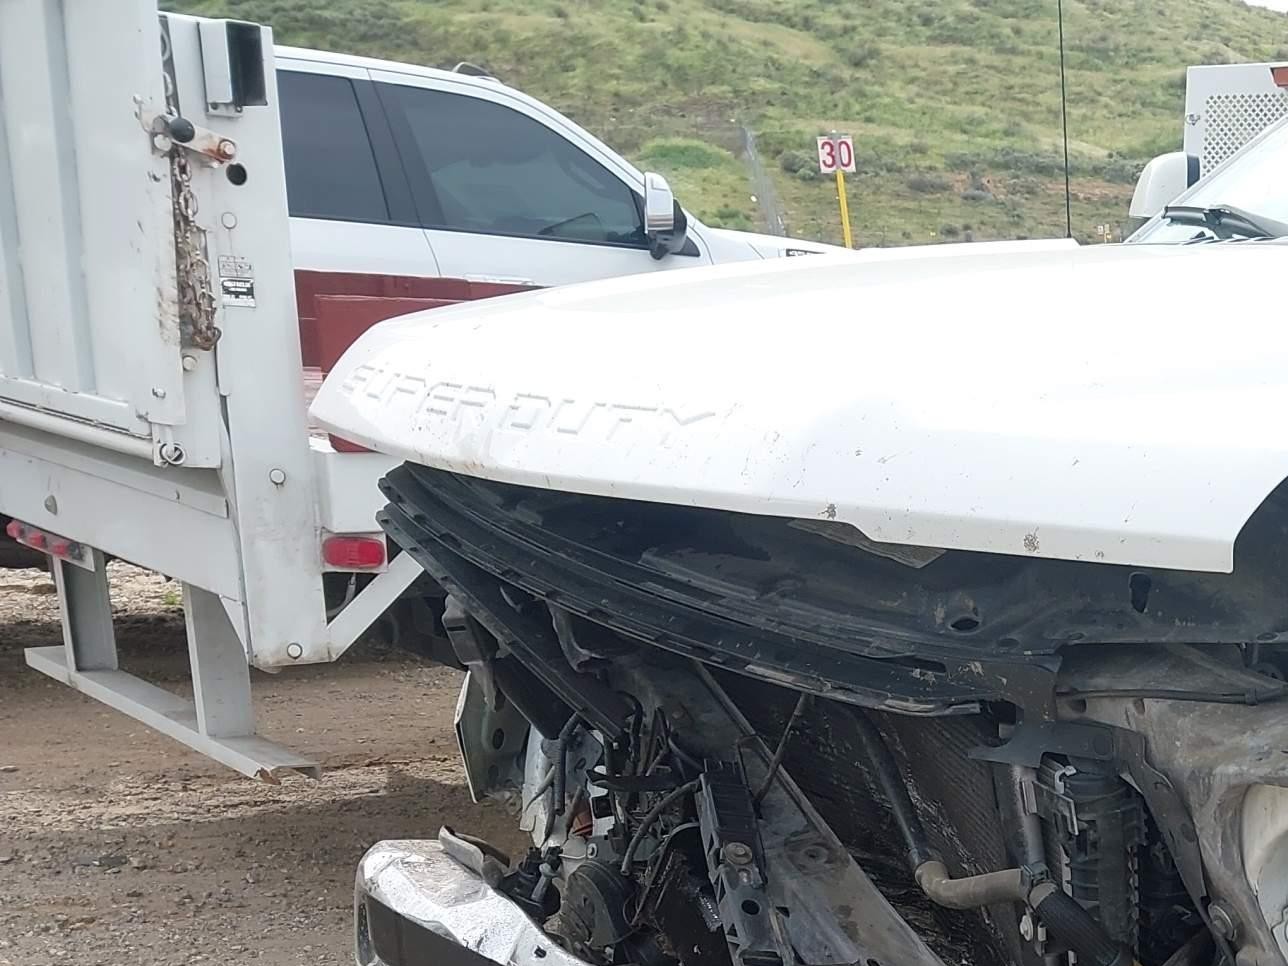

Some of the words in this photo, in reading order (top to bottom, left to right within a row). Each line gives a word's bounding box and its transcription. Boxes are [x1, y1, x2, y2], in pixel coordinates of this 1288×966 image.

[820, 140, 853, 168] 30
[338, 363, 497, 420] SUPER
[499, 392, 717, 446] DUTY
